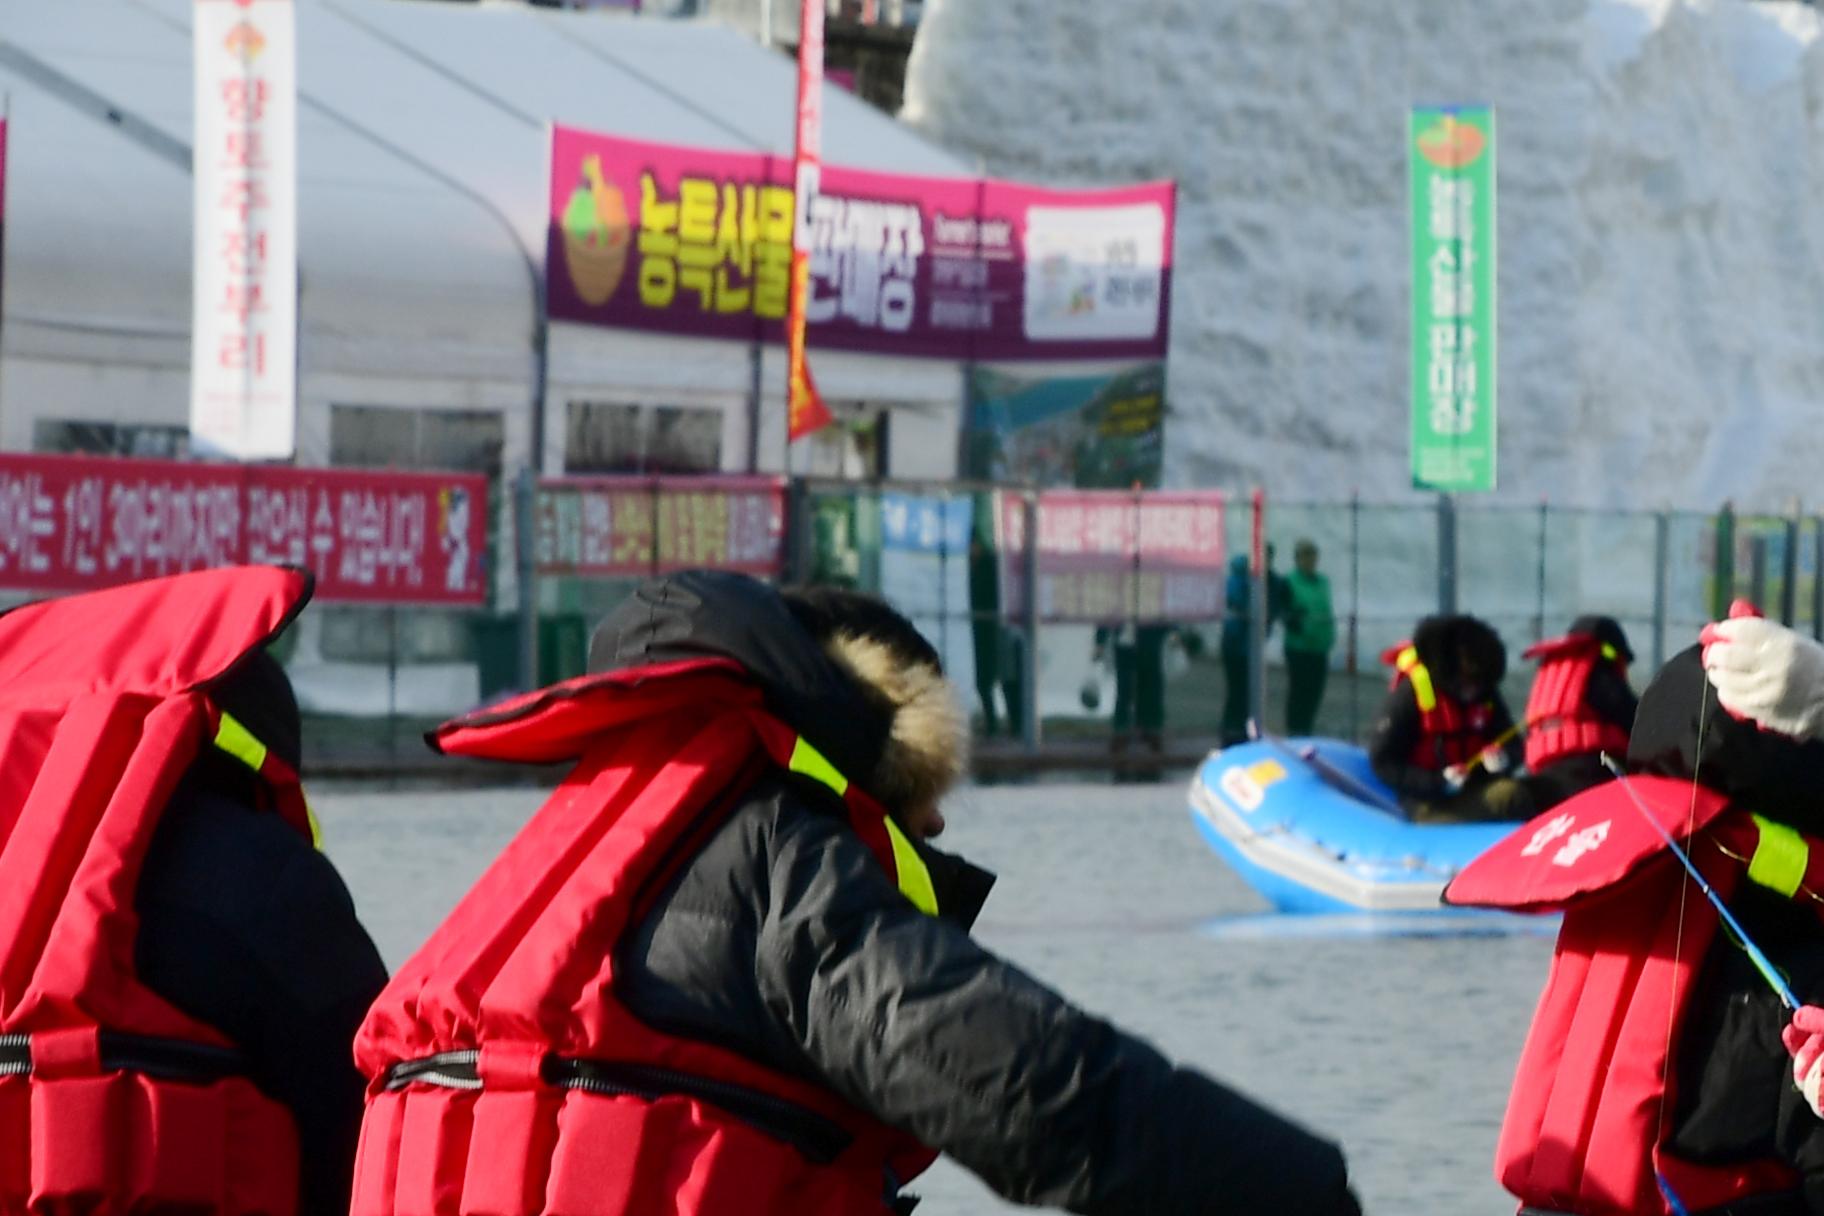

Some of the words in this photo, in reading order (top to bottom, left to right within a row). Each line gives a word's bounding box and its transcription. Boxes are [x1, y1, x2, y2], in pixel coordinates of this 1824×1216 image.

[638, 172, 796, 319] 농특산물
[0, 472, 55, 574] 어는
[63, 478, 103, 575] 1인
[106, 478, 241, 578] 3마리까지만
[312, 488, 334, 584] 수
[339, 490, 426, 587] 있습니다!
